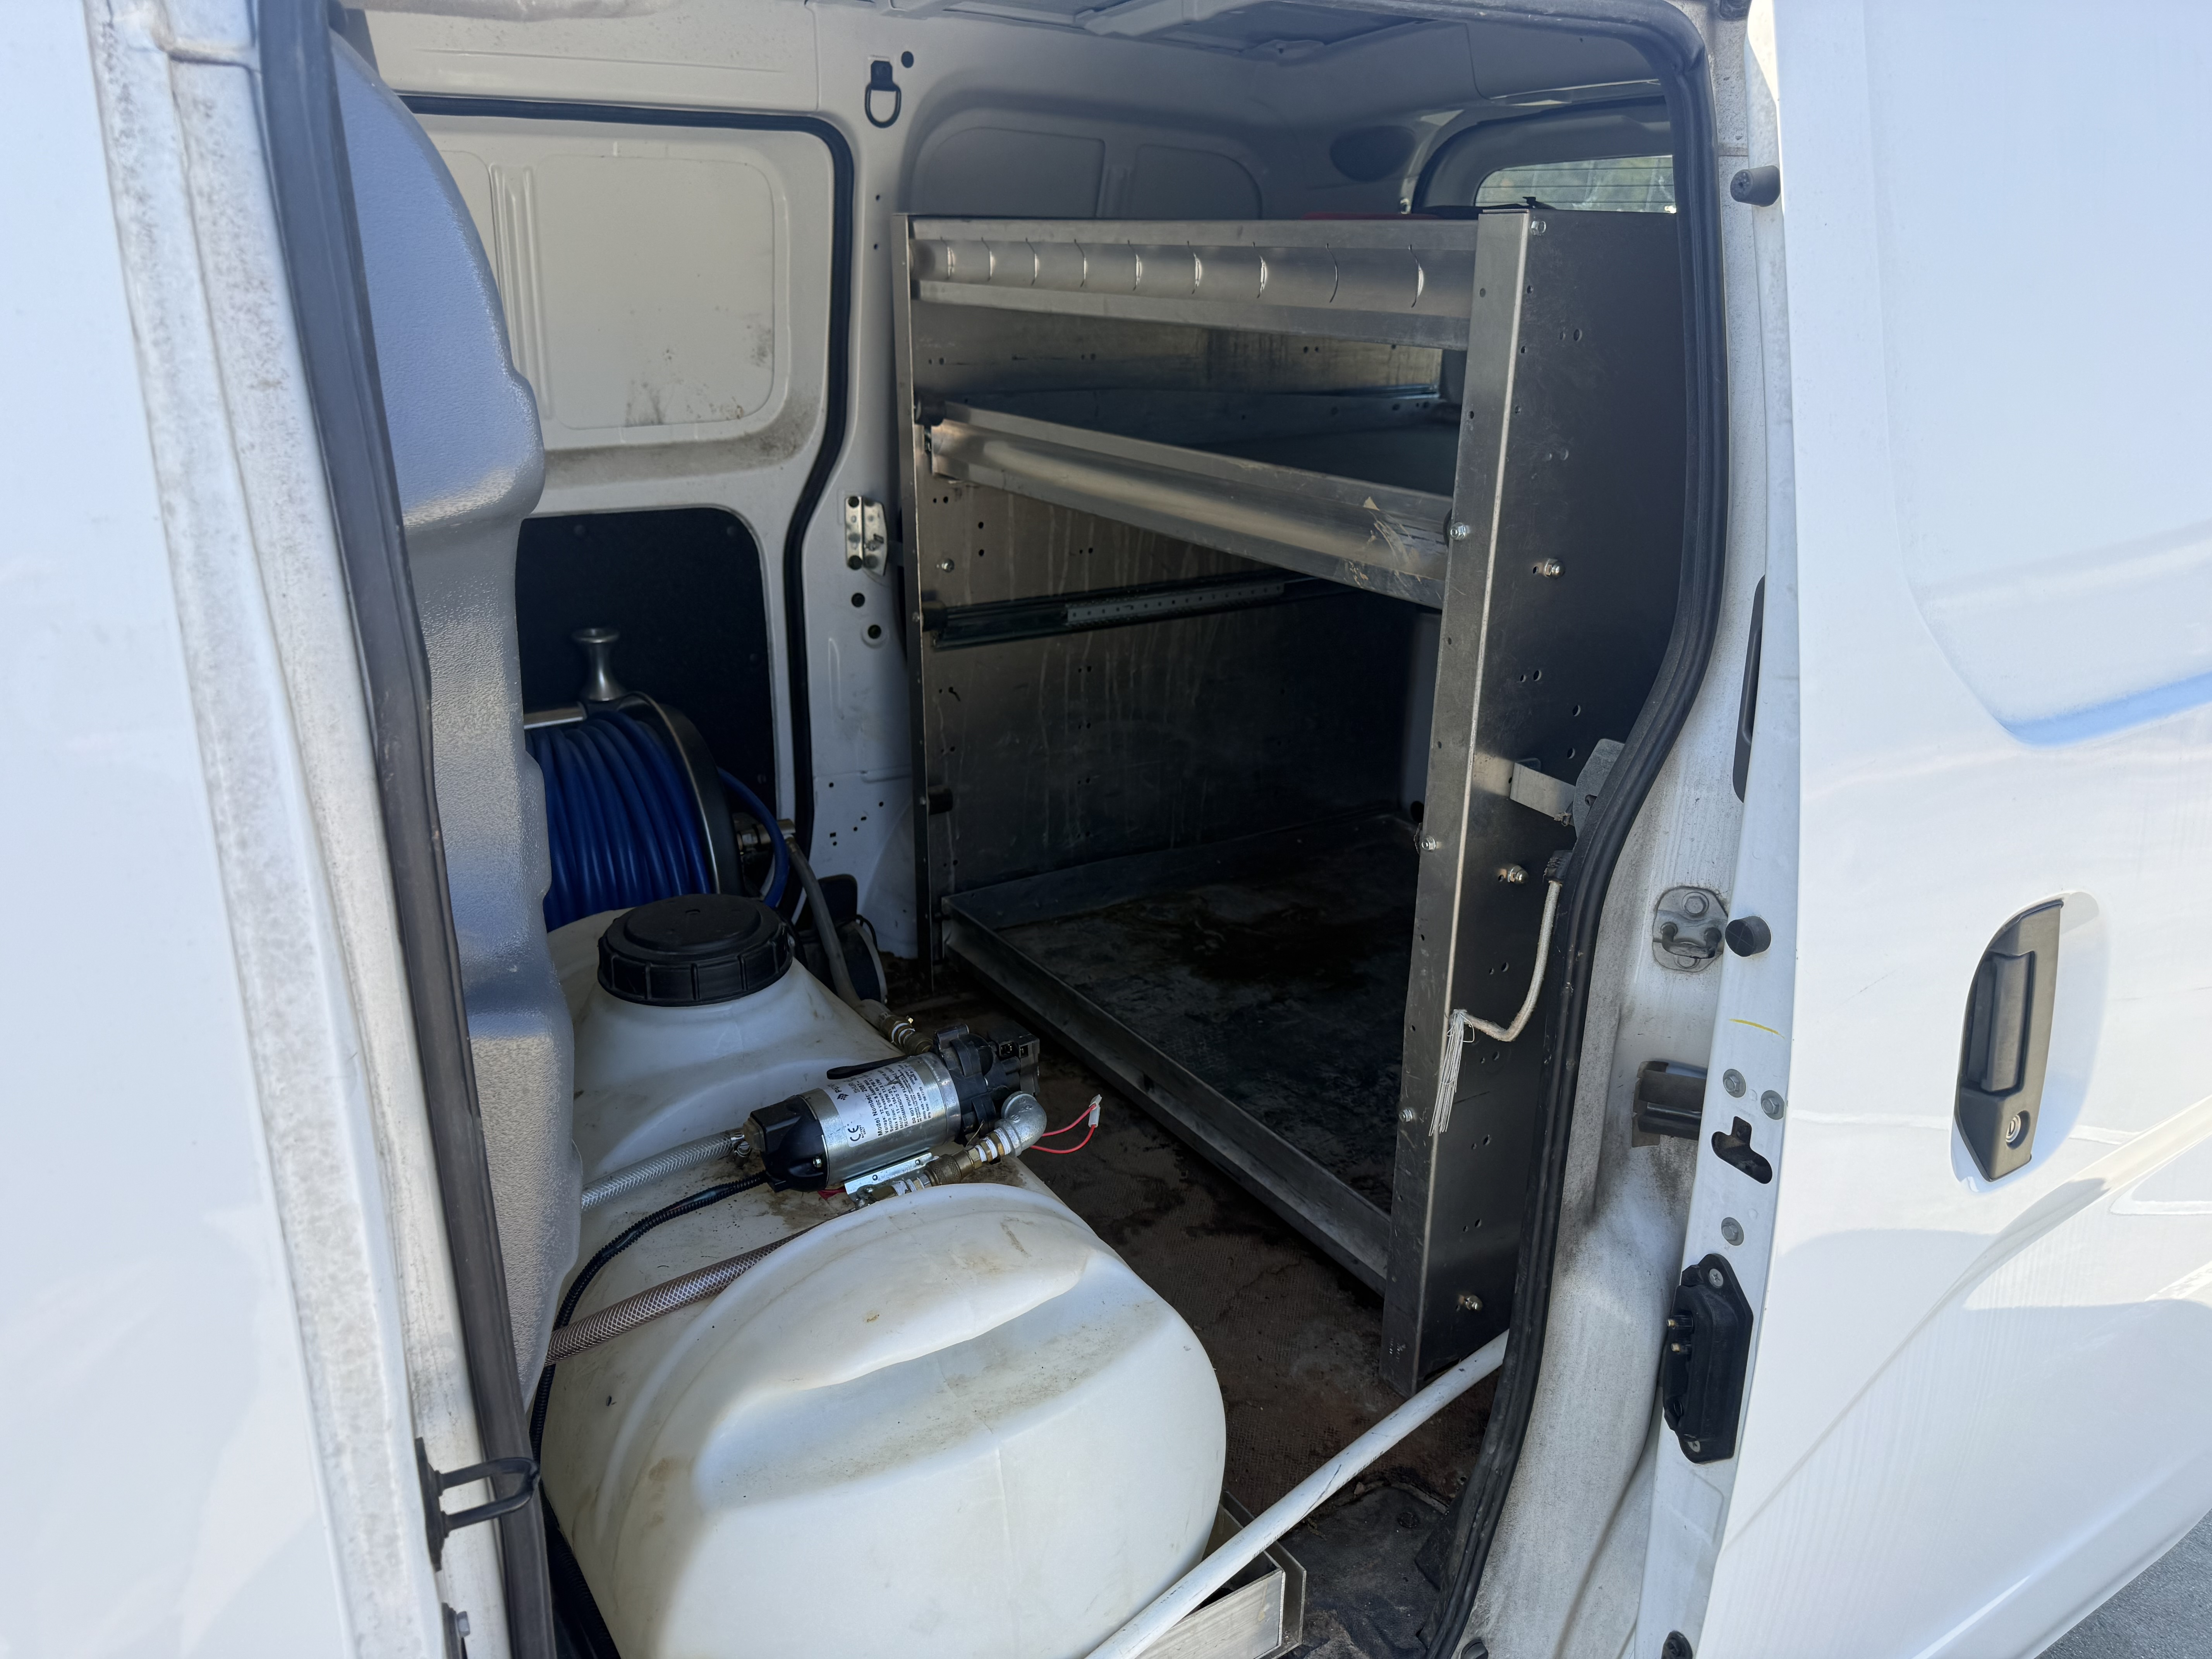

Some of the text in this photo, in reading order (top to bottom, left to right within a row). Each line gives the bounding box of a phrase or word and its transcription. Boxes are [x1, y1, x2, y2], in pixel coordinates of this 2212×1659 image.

[868, 1085, 876, 1094] AMPS
[865, 1093, 878, 1116] Number:
[878, 1091, 888, 1109] Pressure:
[895, 1093, 908, 1127] RECOMMENDED
[847, 1125, 860, 1141] CE
[874, 1118, 883, 1136] Model
